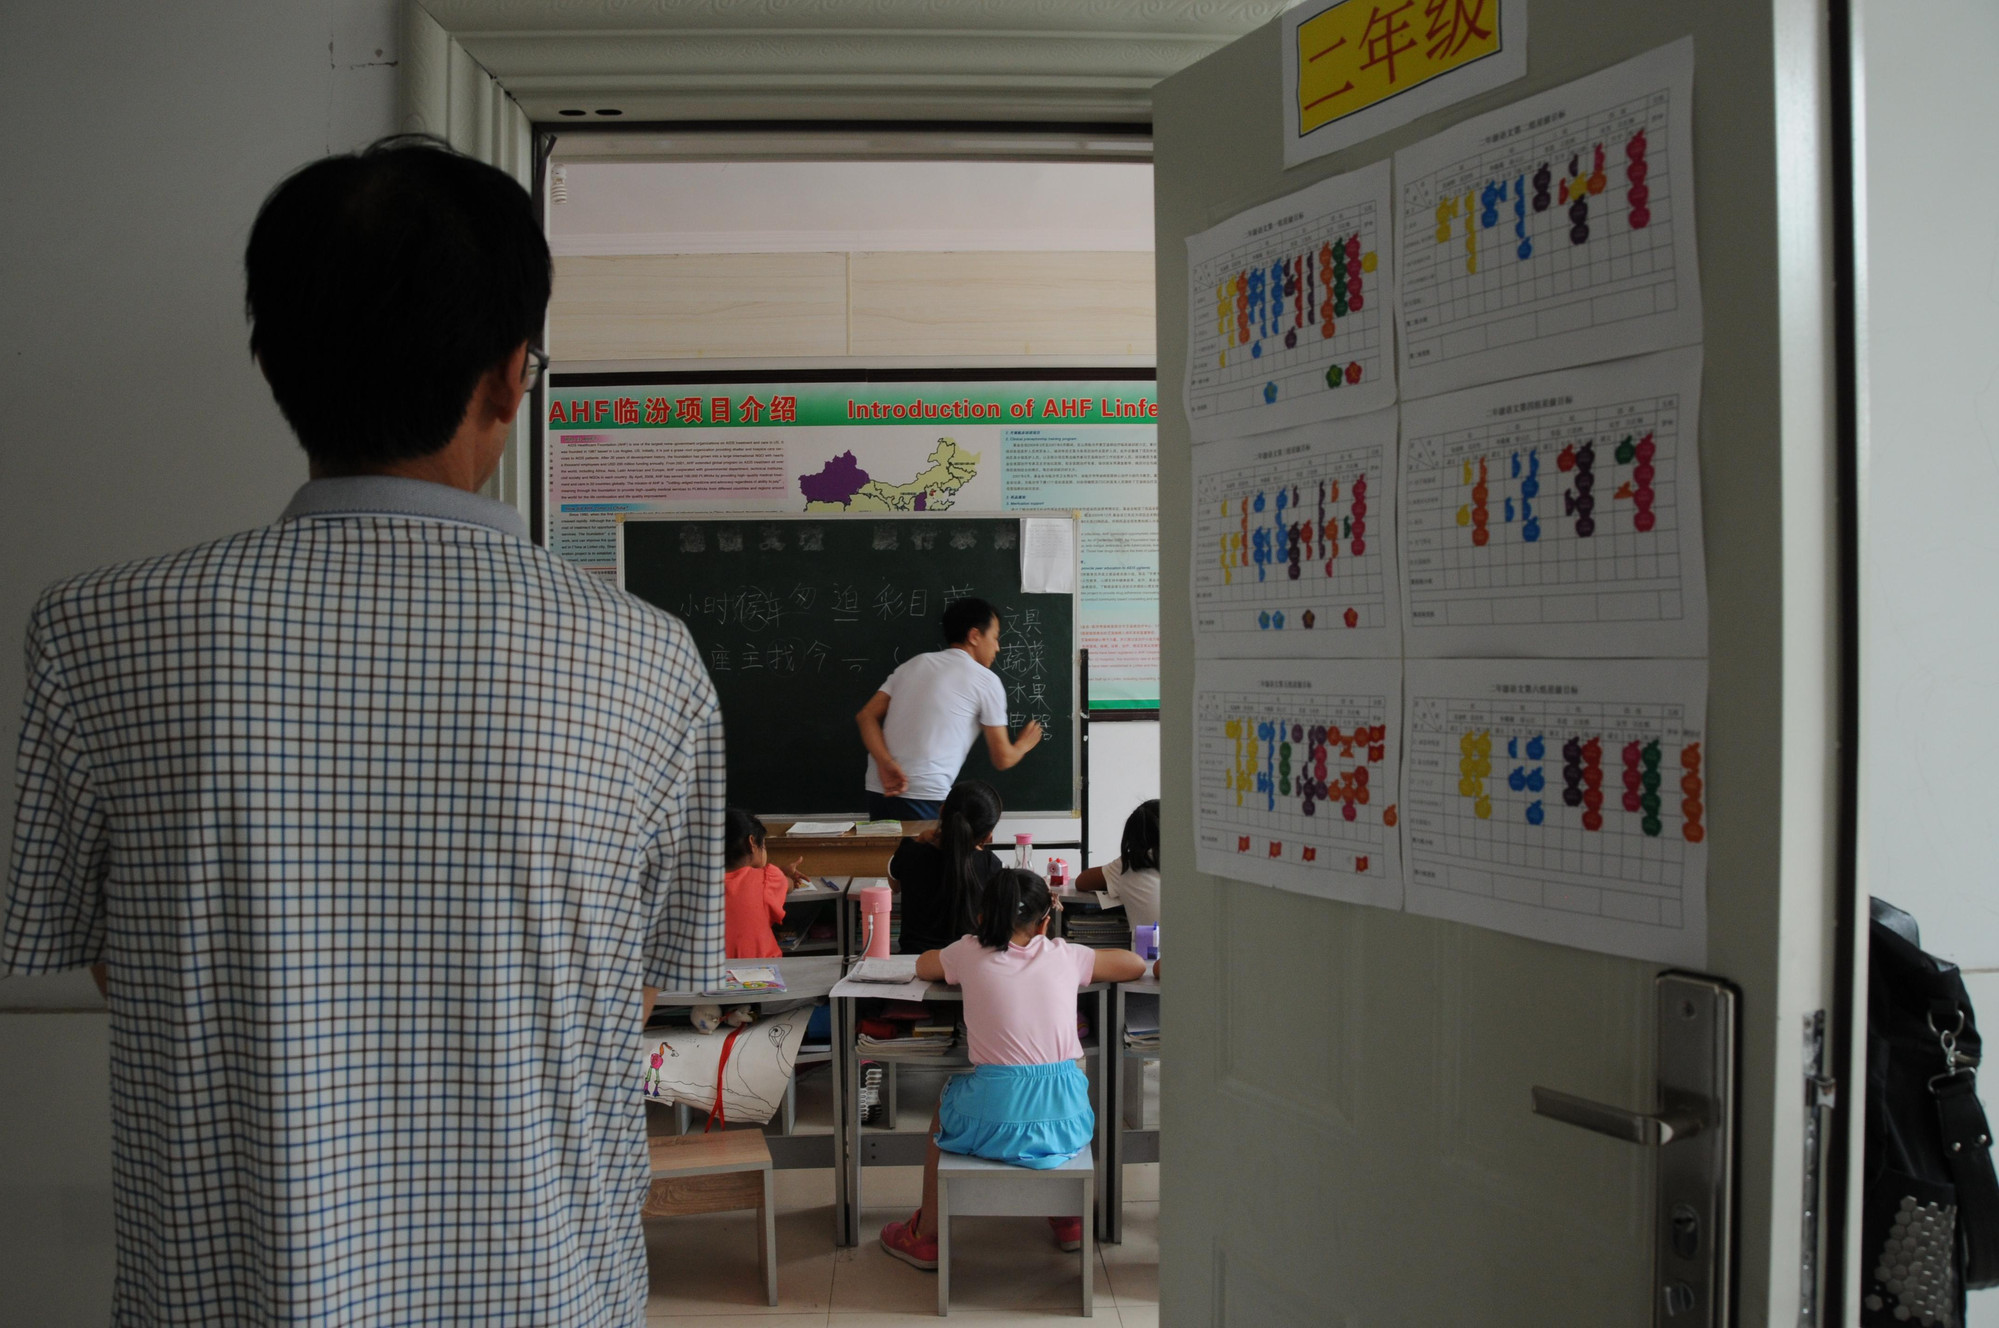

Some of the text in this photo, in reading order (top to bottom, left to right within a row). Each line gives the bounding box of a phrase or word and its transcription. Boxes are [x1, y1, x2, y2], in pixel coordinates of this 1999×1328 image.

[1304, 0, 1492, 111] 二年级
[847, 398, 1001, 420] Introduction
[1010, 398, 1034, 418] of
[1042, 398, 1093, 418] AHF
[1004, 606, 1042, 634] 文具
[1001, 640, 1048, 672] 蔬菜
[1008, 682, 1052, 712] 水果
